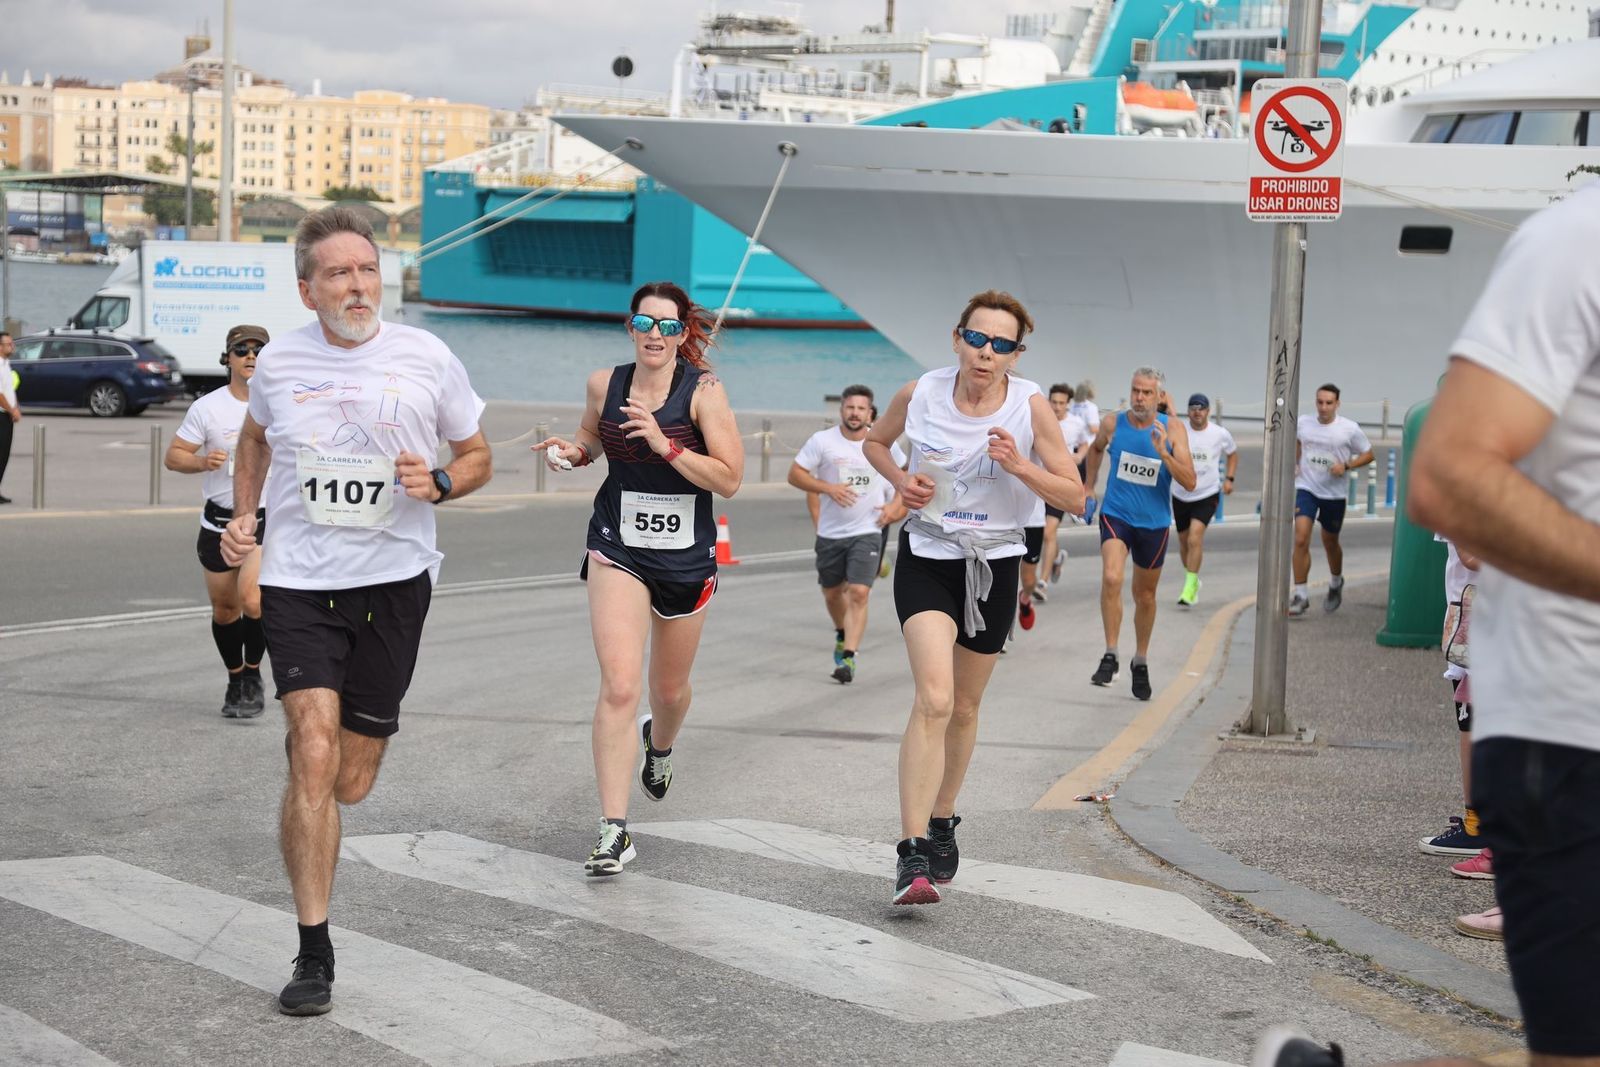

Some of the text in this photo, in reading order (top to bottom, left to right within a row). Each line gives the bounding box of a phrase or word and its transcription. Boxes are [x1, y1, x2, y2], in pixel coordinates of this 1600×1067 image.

[1261, 179, 1329, 193] PROHIBIDO
[1250, 196, 1338, 211] USAR DRONES
[180, 265, 265, 277] LOCAUTO
[327, 456, 362, 464] CARRERA
[1123, 462, 1155, 478] 1020
[847, 475, 870, 486] 229
[304, 476, 385, 505] 1107
[634, 512, 681, 534] 559
[974, 513, 988, 522] VIDA
